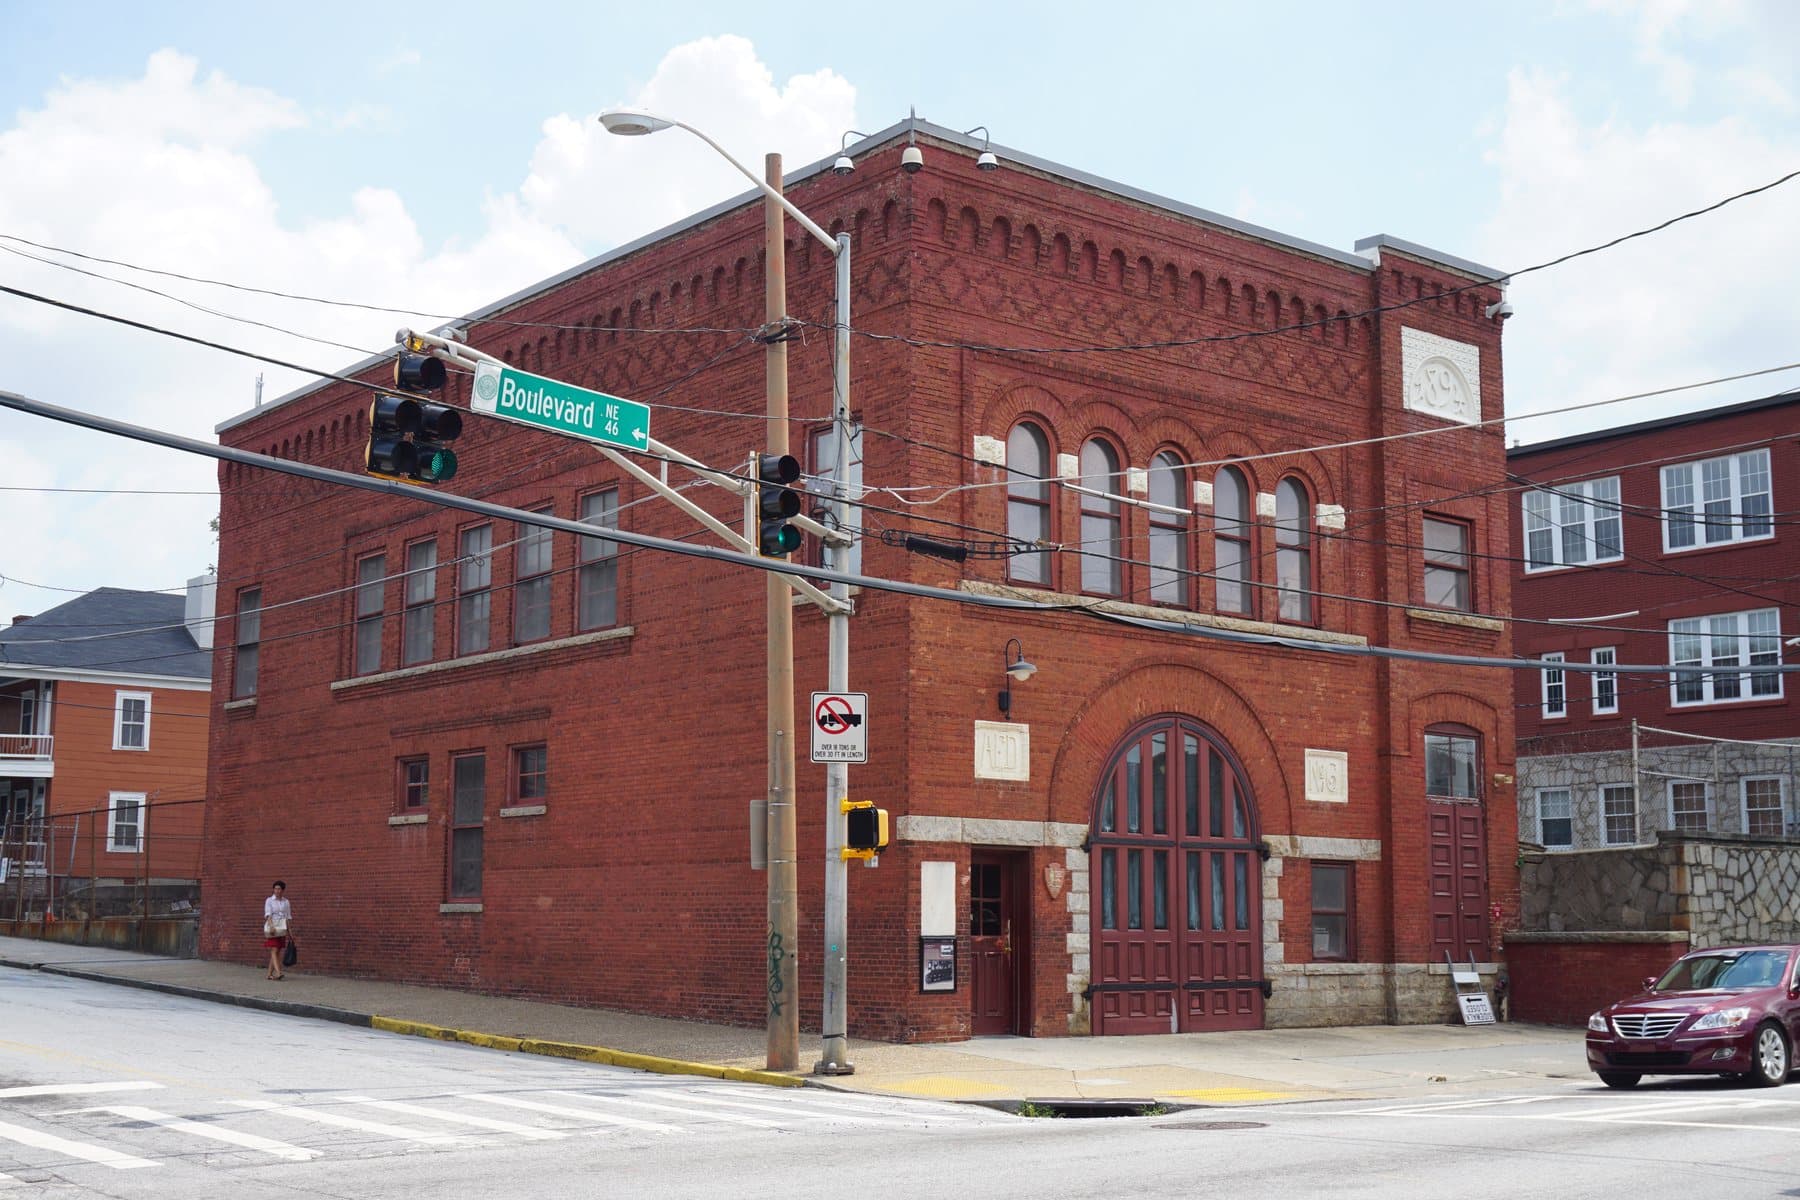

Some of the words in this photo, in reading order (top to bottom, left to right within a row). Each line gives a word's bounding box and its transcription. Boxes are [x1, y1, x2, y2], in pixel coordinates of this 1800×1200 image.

[501, 377, 595, 429] Boulevard
[605, 403, 619, 421] NE
[604, 422, 619, 436] 46
